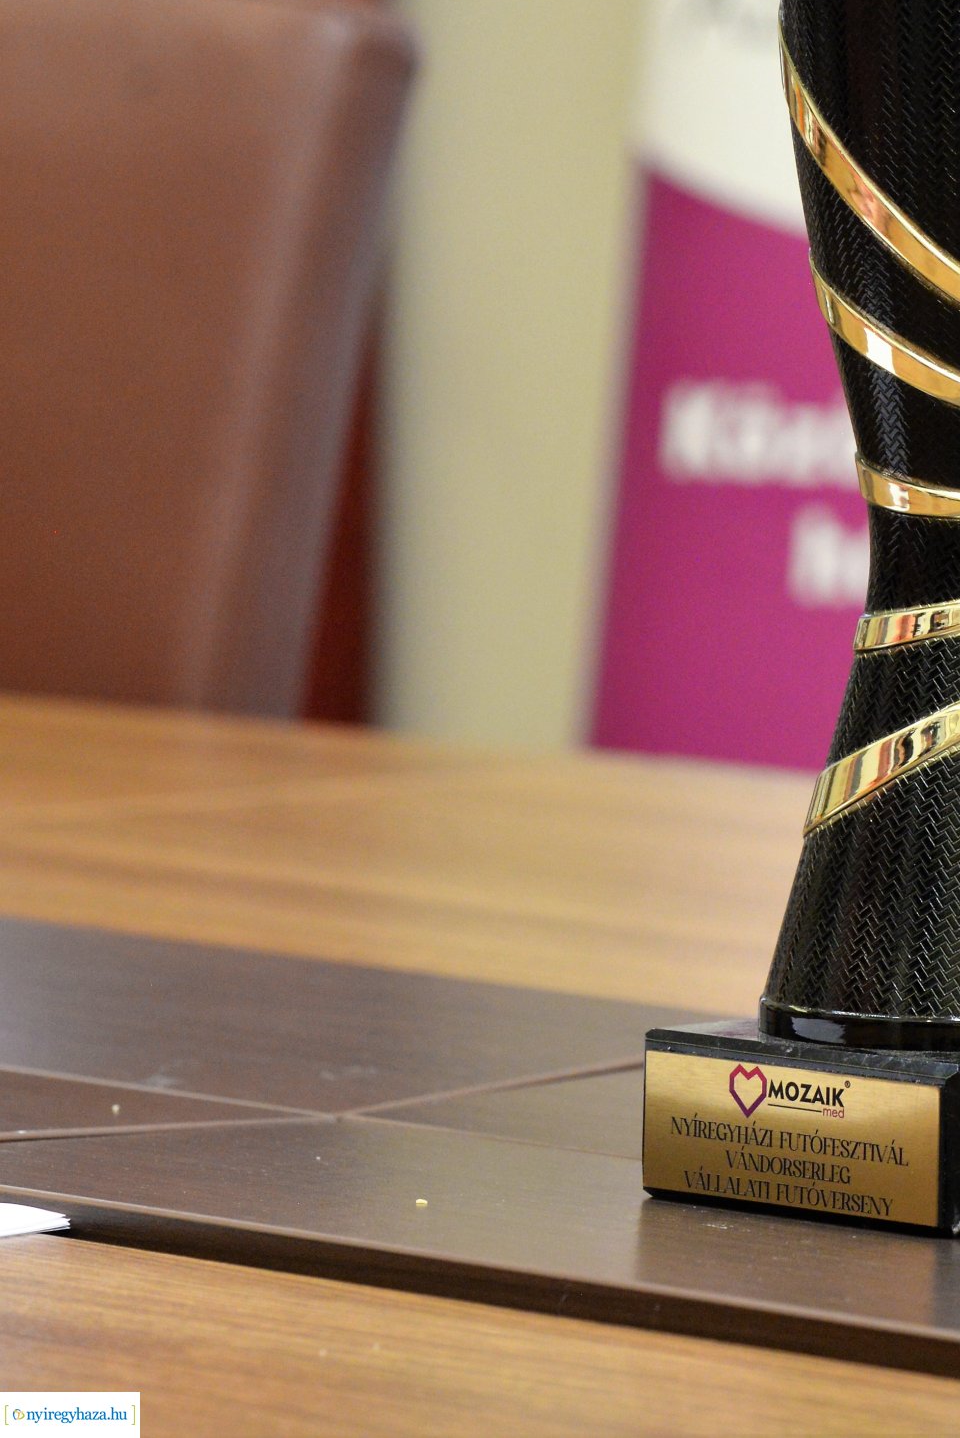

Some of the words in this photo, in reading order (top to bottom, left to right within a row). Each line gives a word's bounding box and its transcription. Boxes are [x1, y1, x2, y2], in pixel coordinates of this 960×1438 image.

[822, 1107, 845, 1119] med
[670, 1113, 773, 1149] NYÍREGYHÁZI
[780, 1129, 909, 1167] FUTÓFESZTIVÁL
[726, 1146, 851, 1184] VÁNDORSERLEG
[684, 1166, 770, 1200] VÁLLALATI
[776, 1182, 893, 1216] FUTÓVERSENY
